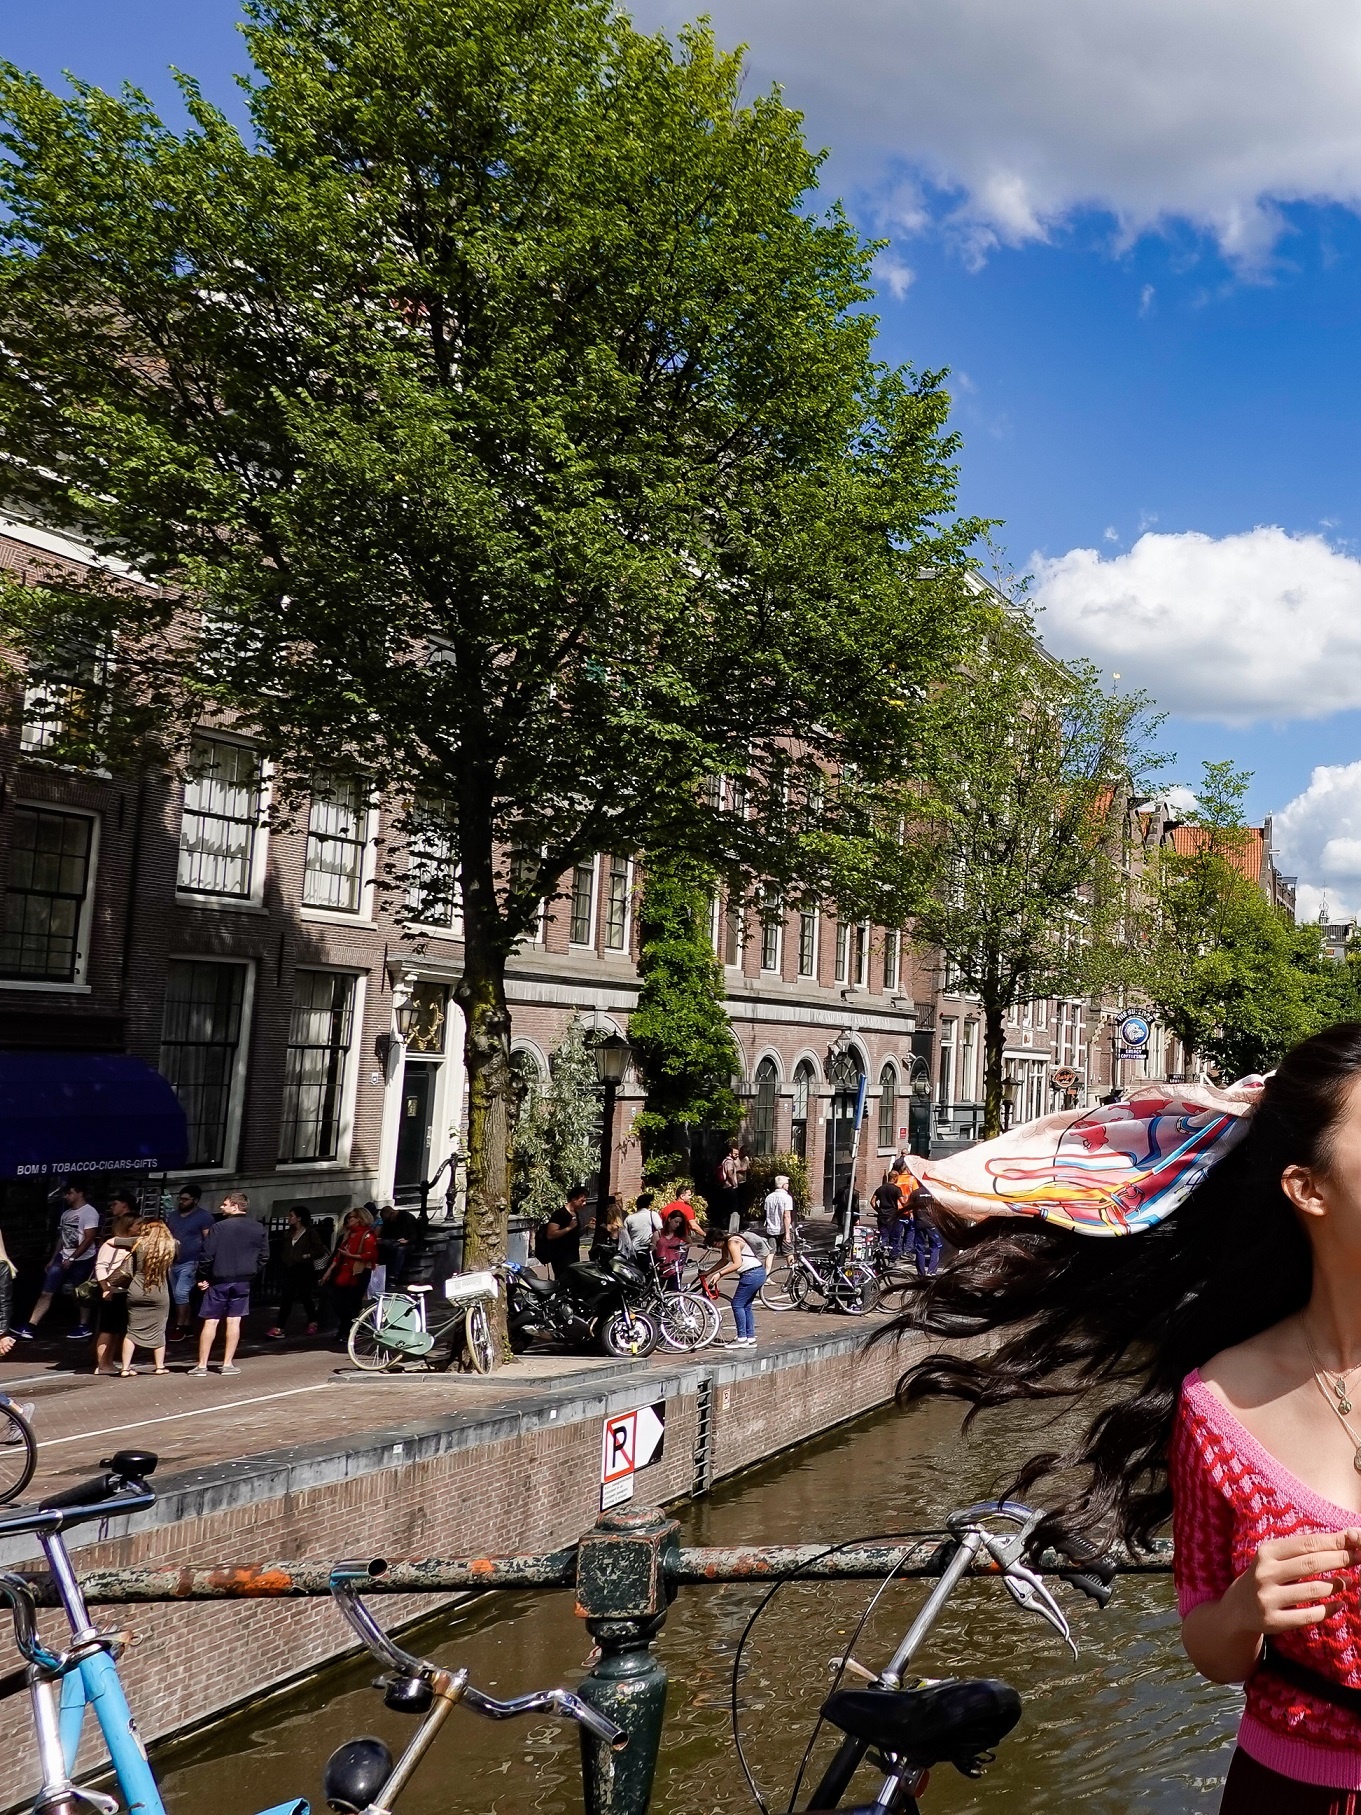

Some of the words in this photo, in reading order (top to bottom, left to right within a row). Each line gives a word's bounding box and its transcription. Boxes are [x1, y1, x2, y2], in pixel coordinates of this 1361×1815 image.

[16, 1165, 40, 1175] BOM
[41, 1164, 48, 1174] 9
[51, 1158, 159, 1173] TOBACCO-CIGARS-GIFTS
[612, 1425, 628, 1468] P
